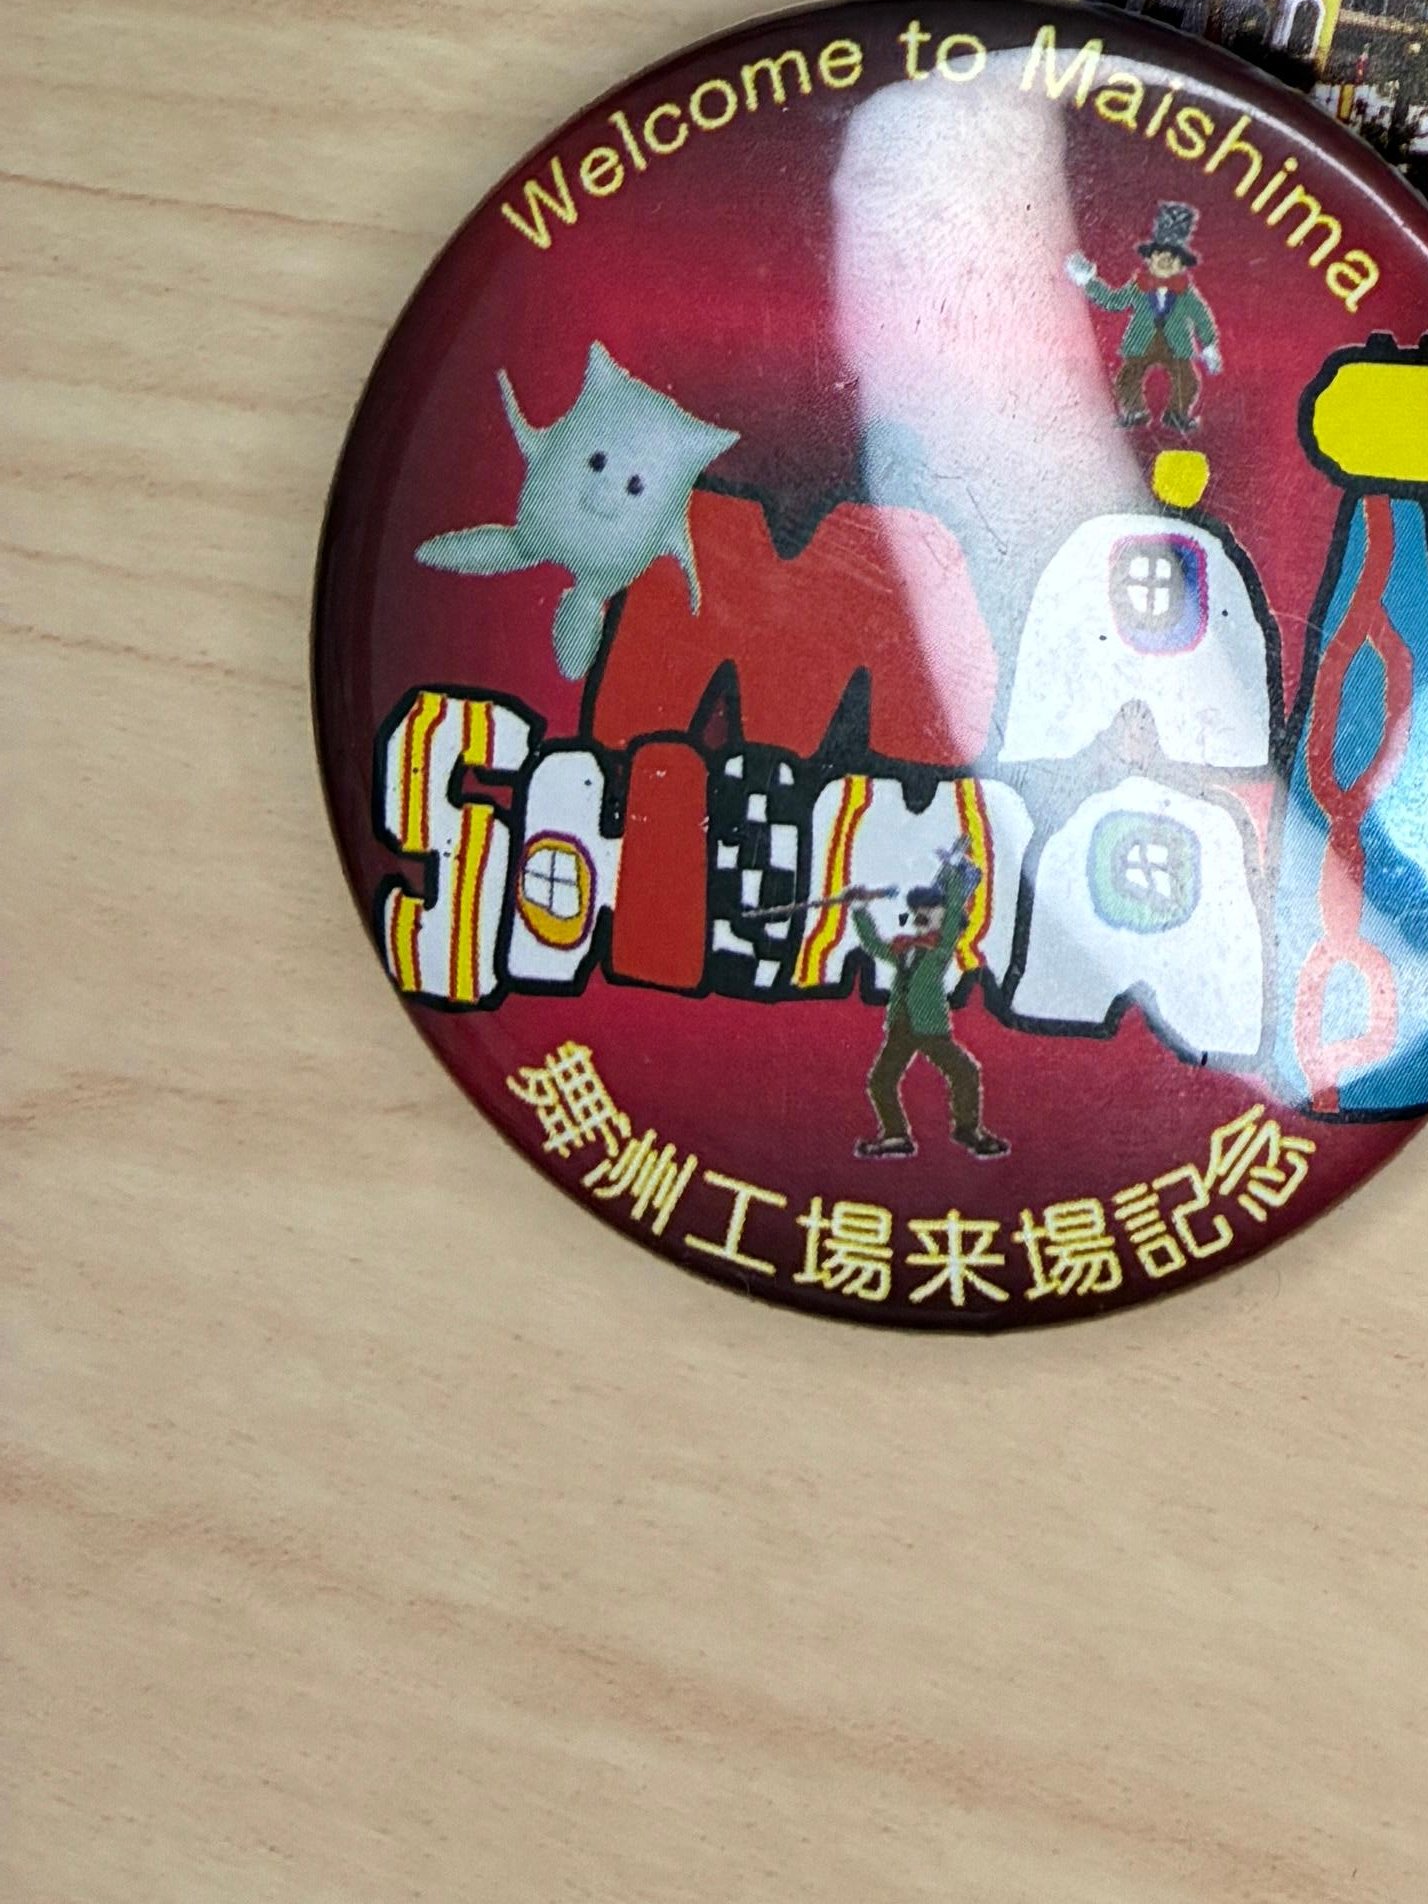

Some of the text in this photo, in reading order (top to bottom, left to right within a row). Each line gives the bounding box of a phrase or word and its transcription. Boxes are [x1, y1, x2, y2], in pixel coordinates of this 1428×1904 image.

[501, 19, 1382, 315] Welcome to Maishima
[504, 1039, 1318, 1308] 舞洲工場来場記念
